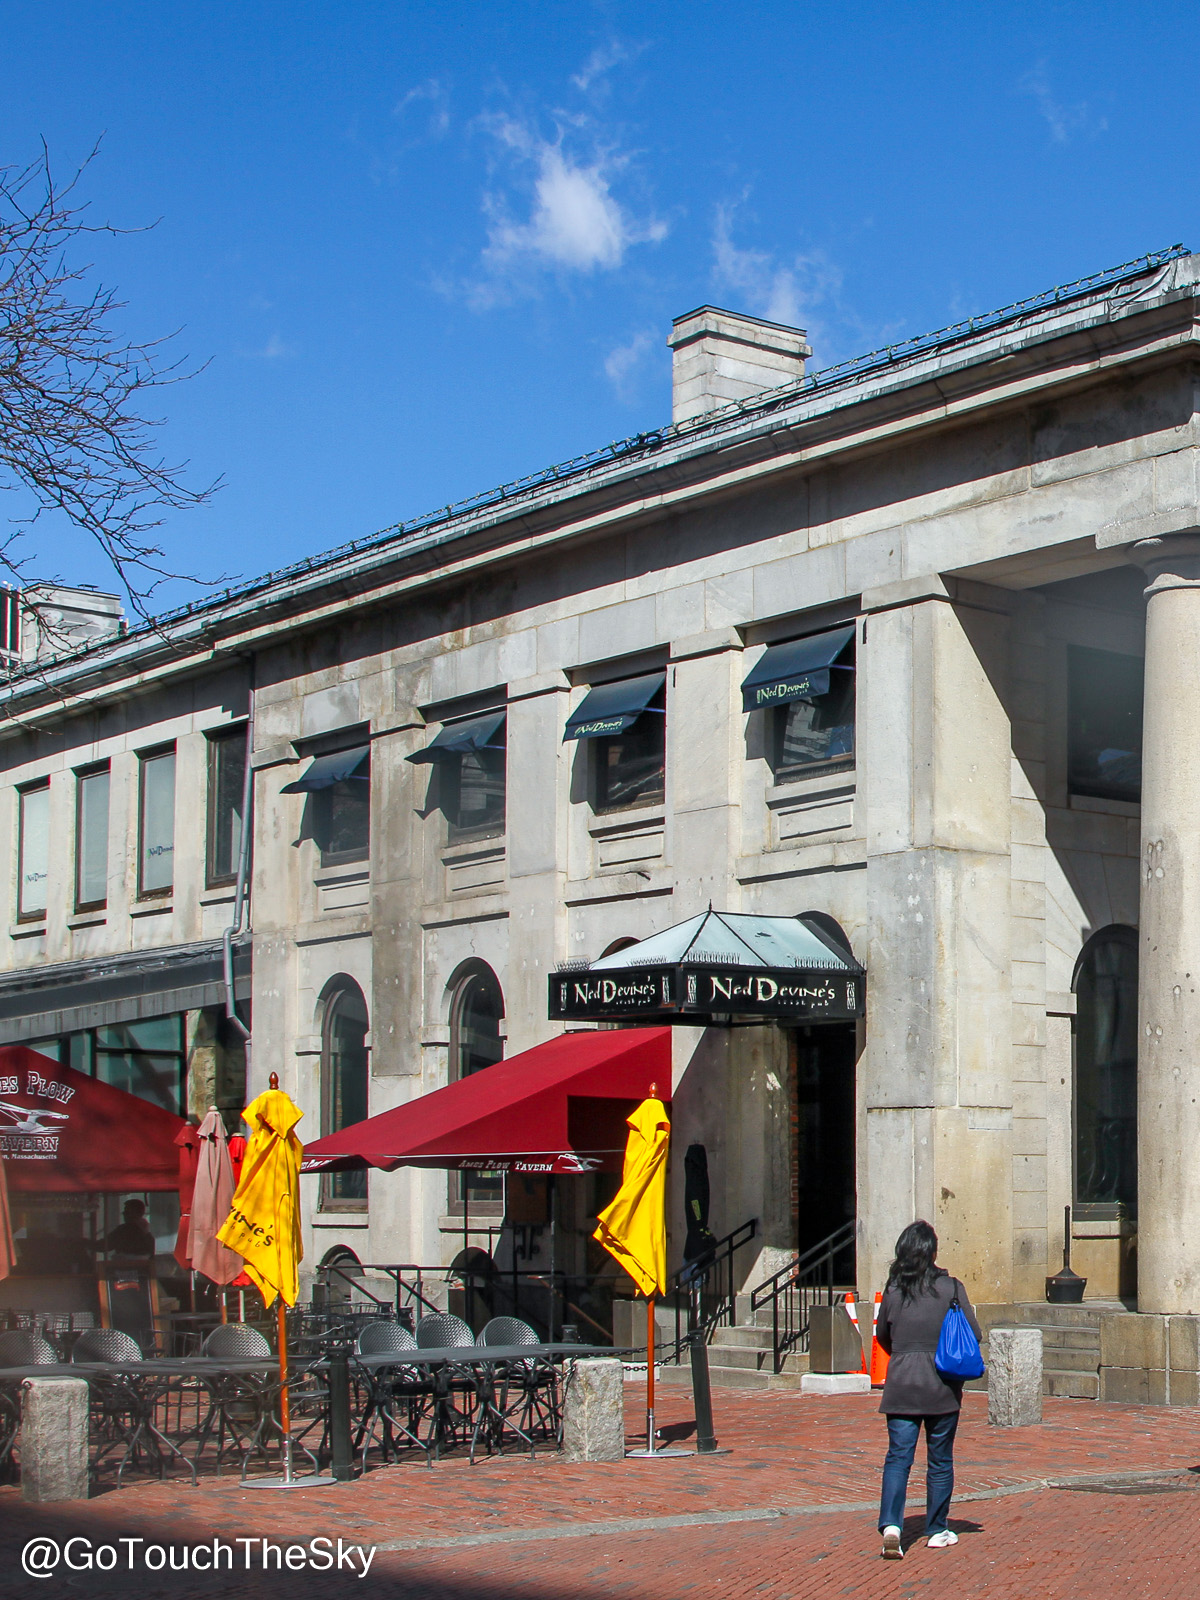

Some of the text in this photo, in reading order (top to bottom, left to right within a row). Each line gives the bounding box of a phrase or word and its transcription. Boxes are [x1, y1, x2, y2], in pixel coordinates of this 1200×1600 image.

[574, 980, 601, 1005] Ned
[710, 976, 753, 1002] Ned
[27, 1070, 76, 1105] PLOW
[514, 1160, 554, 1172] TAVERN
